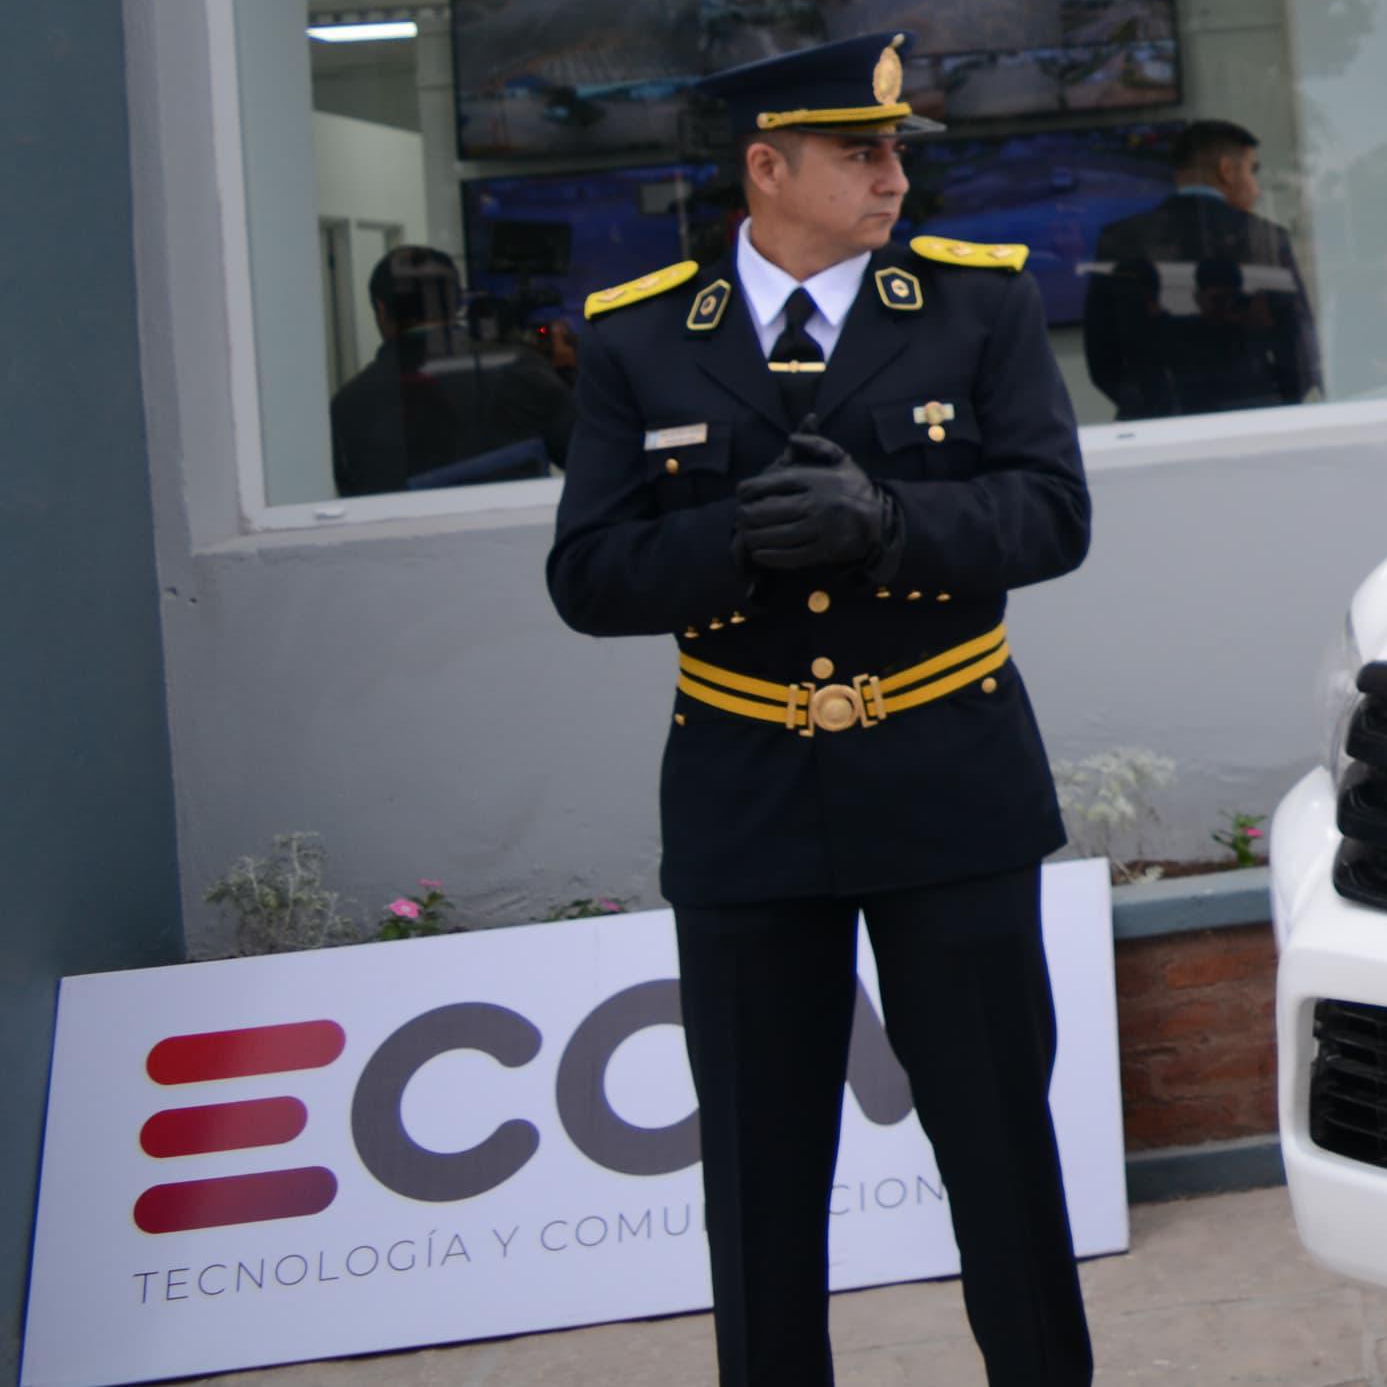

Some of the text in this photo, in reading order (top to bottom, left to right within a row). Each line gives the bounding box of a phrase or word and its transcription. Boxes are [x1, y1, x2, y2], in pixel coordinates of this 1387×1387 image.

[133, 972, 914, 1234] ECO
[132, 1228, 472, 1305] TECNOLOGÍA
[491, 1225, 520, 1259] Y
